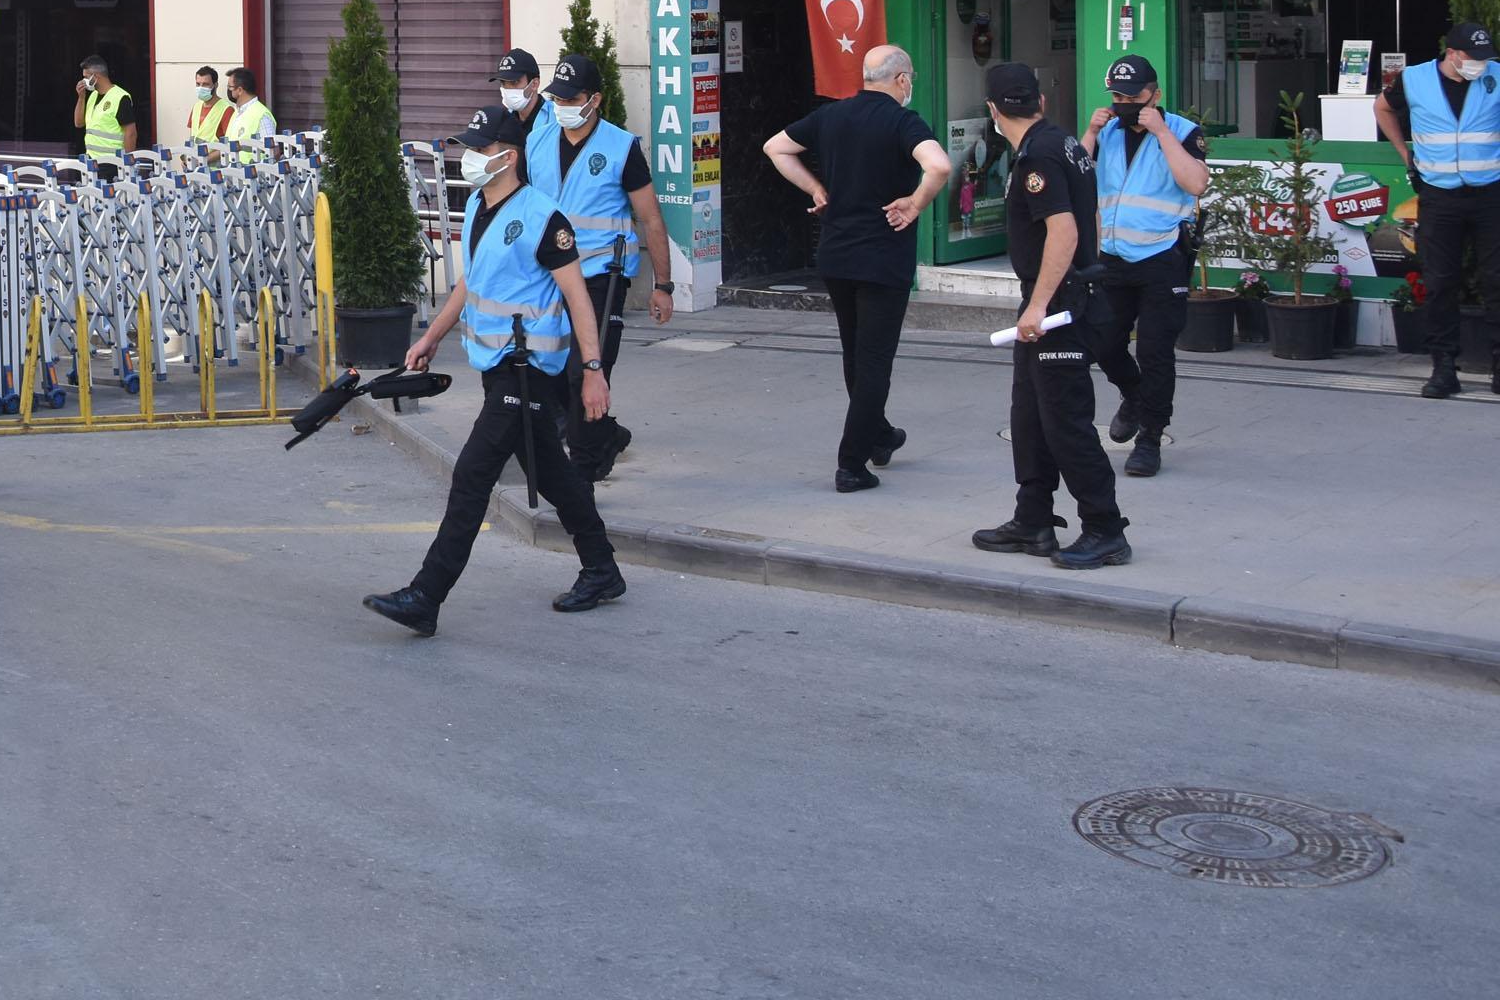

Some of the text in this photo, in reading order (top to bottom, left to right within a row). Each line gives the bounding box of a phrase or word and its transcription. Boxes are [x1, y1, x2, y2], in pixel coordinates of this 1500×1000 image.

[656, 194, 692, 205] ERKEZİ
[1335, 197, 1383, 215] 250 ŞUBE
